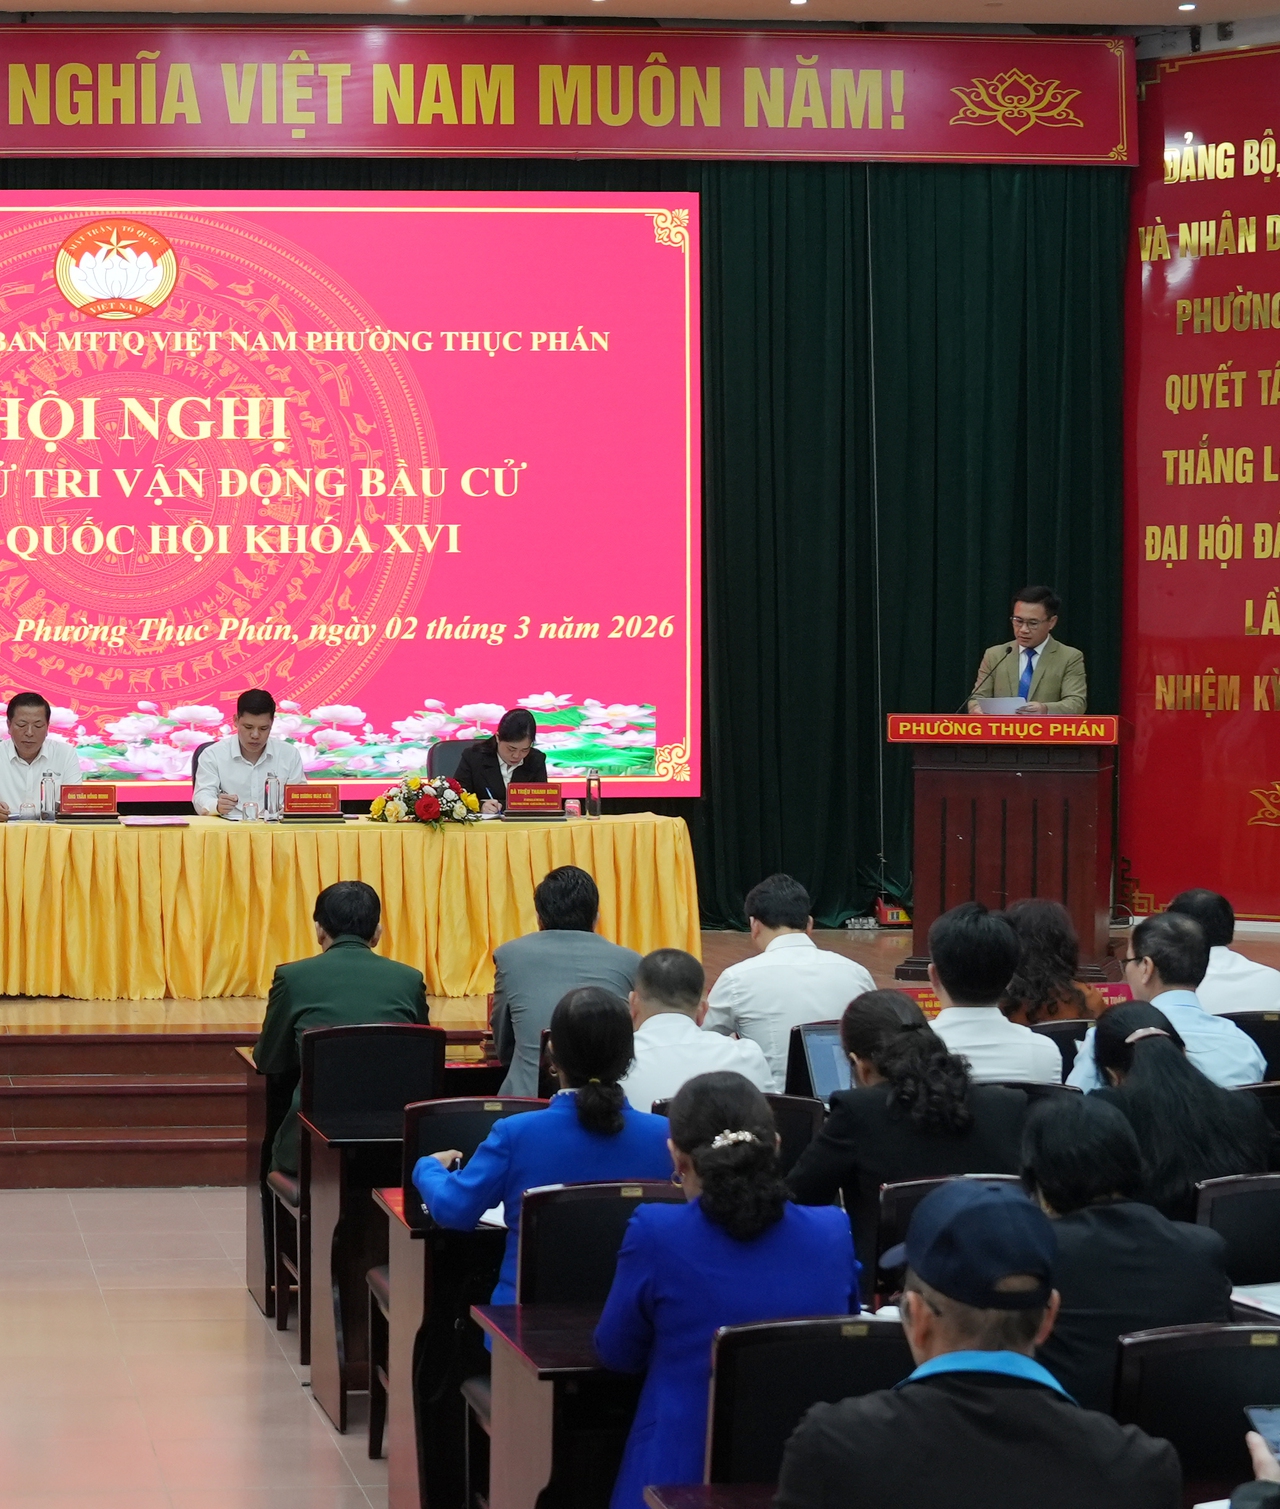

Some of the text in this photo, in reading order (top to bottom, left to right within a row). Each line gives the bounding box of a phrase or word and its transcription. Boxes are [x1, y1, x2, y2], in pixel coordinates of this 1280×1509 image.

[8, 50, 202, 126] NGHĨA
[221, 49, 351, 139] VIỆT
[372, 64, 515, 125] NAM
[538, 52, 722, 127] MUÔN
[743, 54, 906, 130] NĂM!
[1163, 131, 1235, 185] ĐẢNG
[1138, 216, 1171, 262] VÀ
[1178, 210, 1256, 258] NHÂN
[119, 302, 143, 314] NAM
[57, 332, 147, 358] MTTQ
[150, 328, 223, 358] VIỆT
[230, 332, 298, 353] NAM
[306, 326, 433, 352] PHƯỜNG
[441, 331, 523, 358] THỤC
[530, 325, 610, 352] PHÁN
[1165, 360, 1247, 415] QUYẾT
[118, 396, 292, 453] NGHỊ
[25, 468, 102, 499] TRI
[113, 463, 205, 507] VẬN
[217, 463, 346, 507] ĐỘNG
[358, 459, 448, 498] BẦU
[460, 459, 528, 498] CỬ
[1162, 434, 1254, 485] THẮNG
[6, 516, 137, 562] QUỐC
[148, 520, 231, 563] HỘI
[244, 516, 376, 555] KHÓA
[383, 525, 462, 555] XVI
[1145, 524, 1188, 569] ĐẠI
[1198, 515, 1243, 569] HỘI
[12, 615, 676, 648] Phường Thục Phán, ngày 02 tháng 3 năm 2026
[1155, 667, 1240, 718] NHIỆM
[898, 720, 1106, 739] PHƯỜNG THỤC PHÁN
